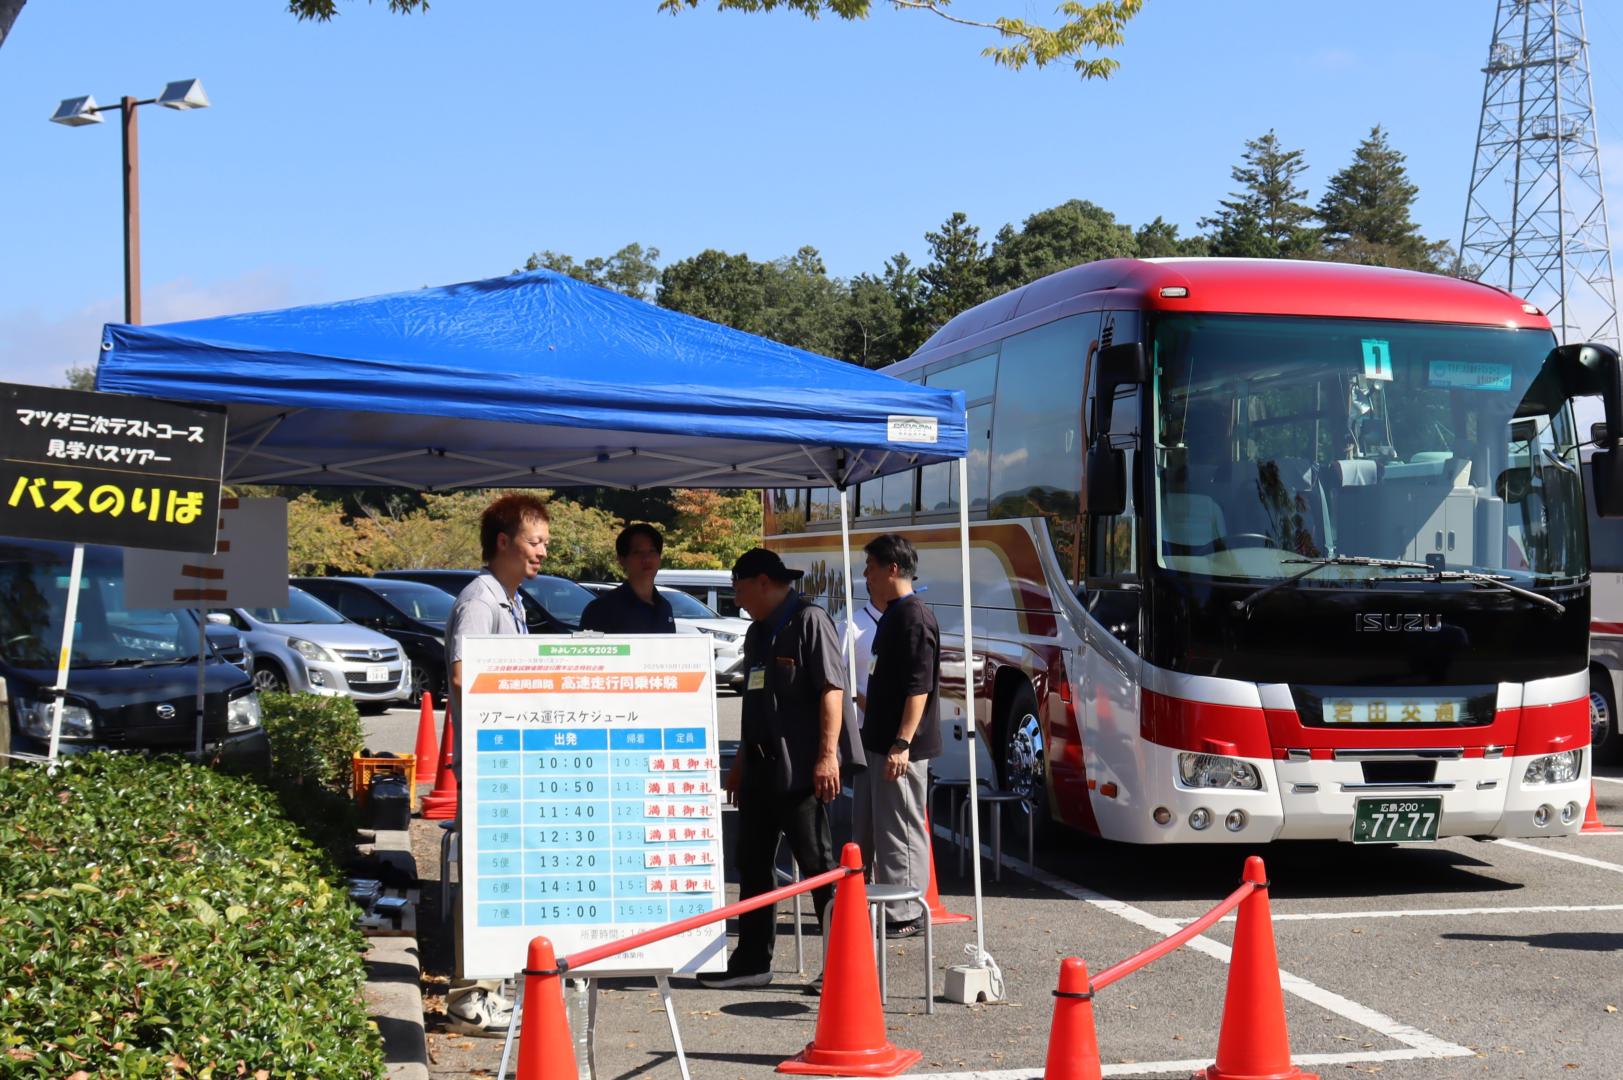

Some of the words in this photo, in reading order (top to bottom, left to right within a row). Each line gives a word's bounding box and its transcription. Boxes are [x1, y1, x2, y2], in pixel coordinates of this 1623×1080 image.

[16, 409, 205, 443] マツダ三次テストコース
[46, 438, 172, 466] 見学バスツアー
[7, 475, 204, 525] バスのりば
[1355, 613, 1443, 632] ISUZU
[550, 646, 618, 654] みよしフェスタ2025
[561, 676, 678, 690] 高速走行同乗体験
[479, 709, 639, 724] ツアーバス運行スケジュール
[554, 733, 577, 746] 出発
[676, 733, 694, 744] 定員
[539, 757, 593, 769] 10:00
[652, 758, 716, 770] 満員御礼
[539, 781, 594, 793] 10:50
[616, 782, 639, 791] 11:
[648, 782, 712, 794] 満員御礼
[539, 805, 595, 818] 11:40
[617, 807, 639, 816] 12:
[648, 804, 713, 817] 満員御礼
[1380, 803, 1398, 812] 広島
[1398, 803, 1418, 812] 200
[1371, 813, 1435, 838] 77-77
[539, 830, 595, 842] 12:30
[617, 830, 640, 840] 13:
[649, 827, 714, 840] 満員御礼
[540, 854, 596, 867] 13:20
[618, 855, 641, 865] 14:
[649, 852, 714, 866] 満員御礼
[540, 879, 597, 893] 14:10
[619, 880, 643, 890] 15:
[650, 879, 715, 891] 満員御礼
[540, 905, 597, 918] 15:00
[619, 905, 663, 915] 15:55
